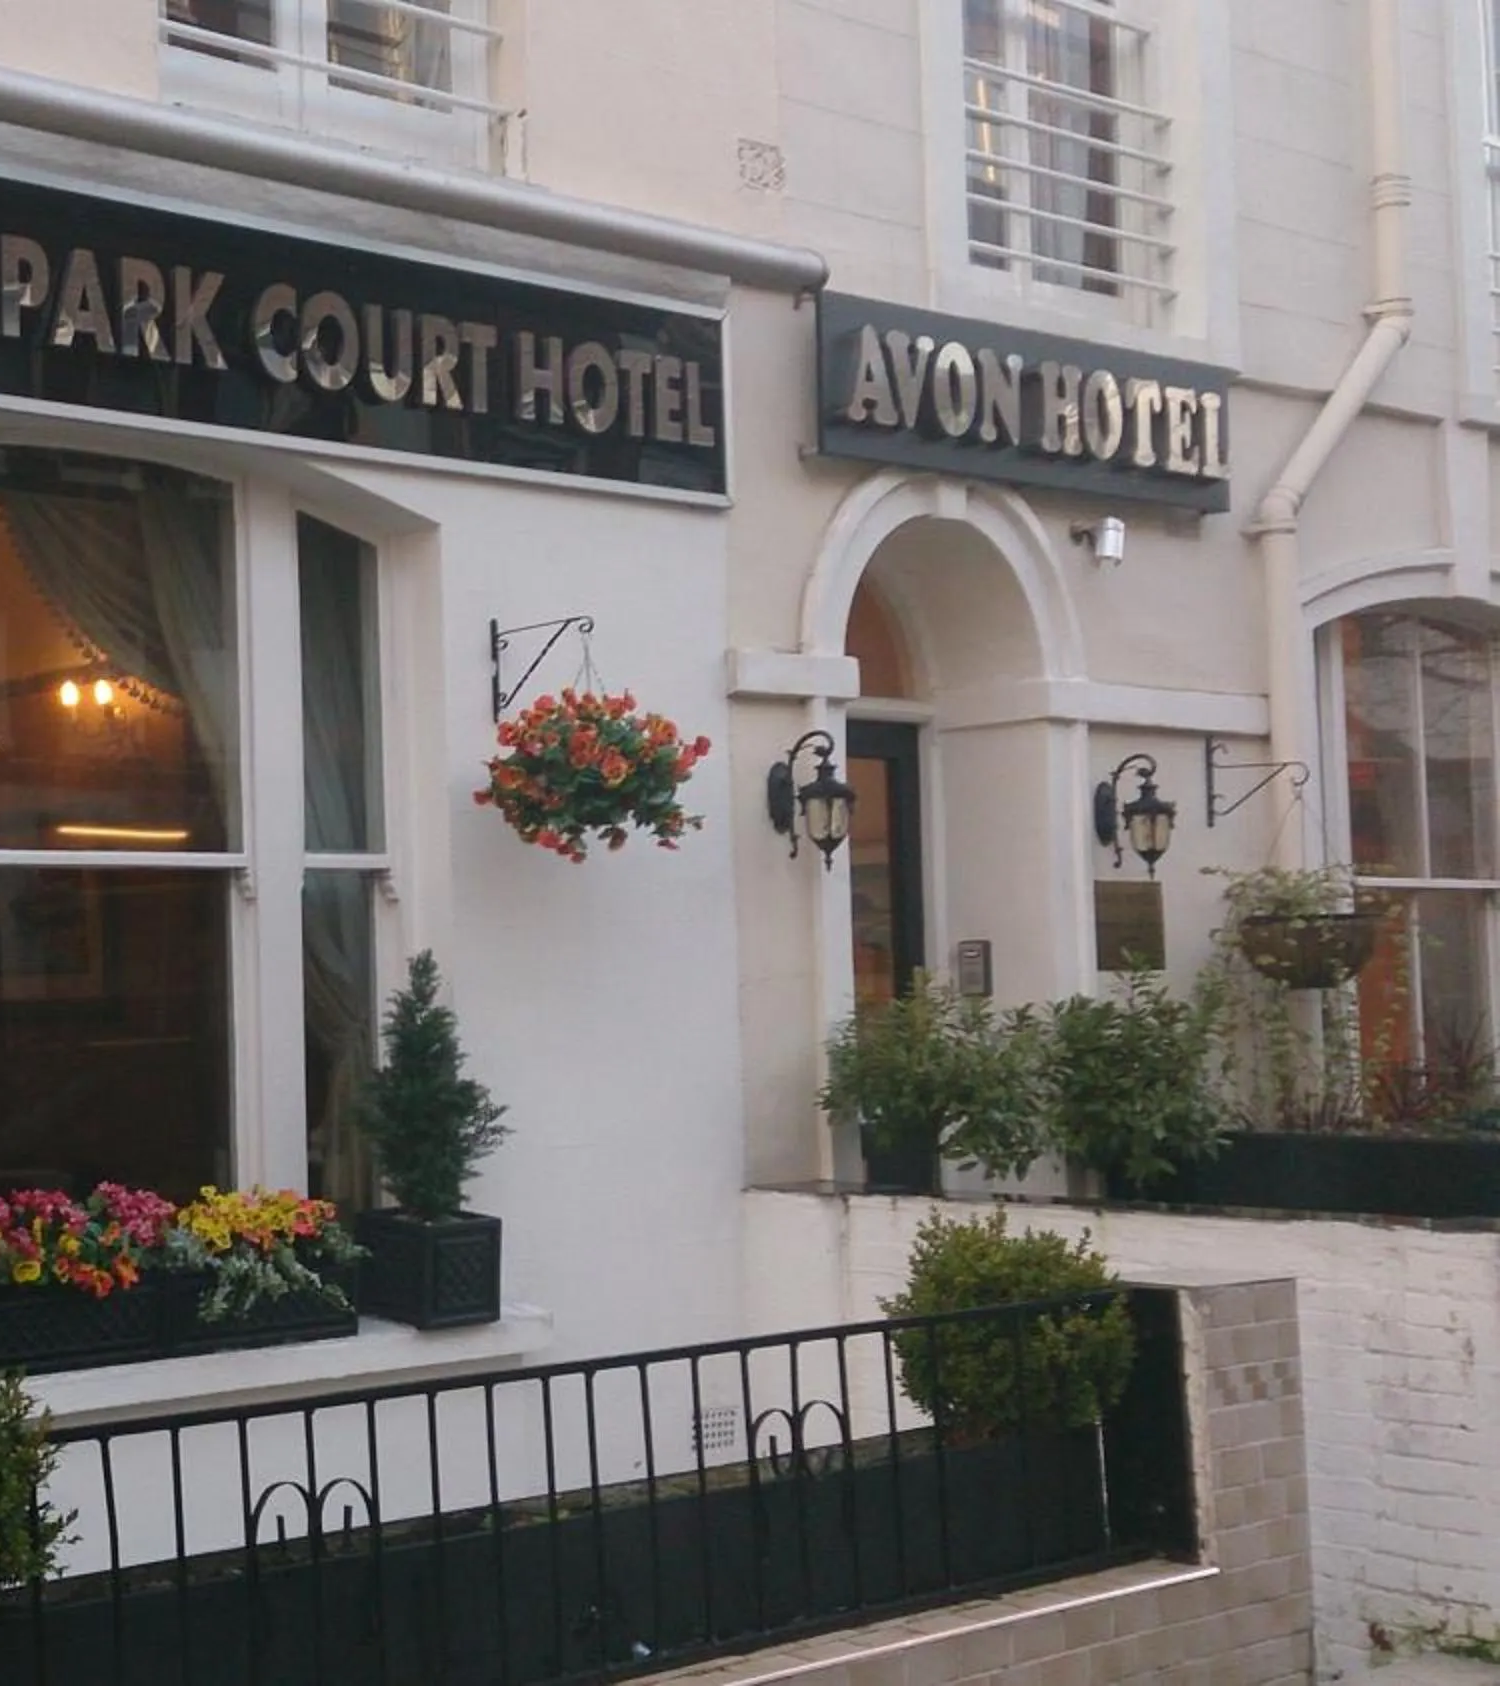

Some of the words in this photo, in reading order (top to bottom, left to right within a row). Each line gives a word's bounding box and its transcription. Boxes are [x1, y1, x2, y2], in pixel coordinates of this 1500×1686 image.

[252, 282, 497, 414] COURT
[514, 331, 716, 448] HOTEL
[847, 324, 1025, 447] AVON
[1037, 360, 1233, 479] HOTEL
